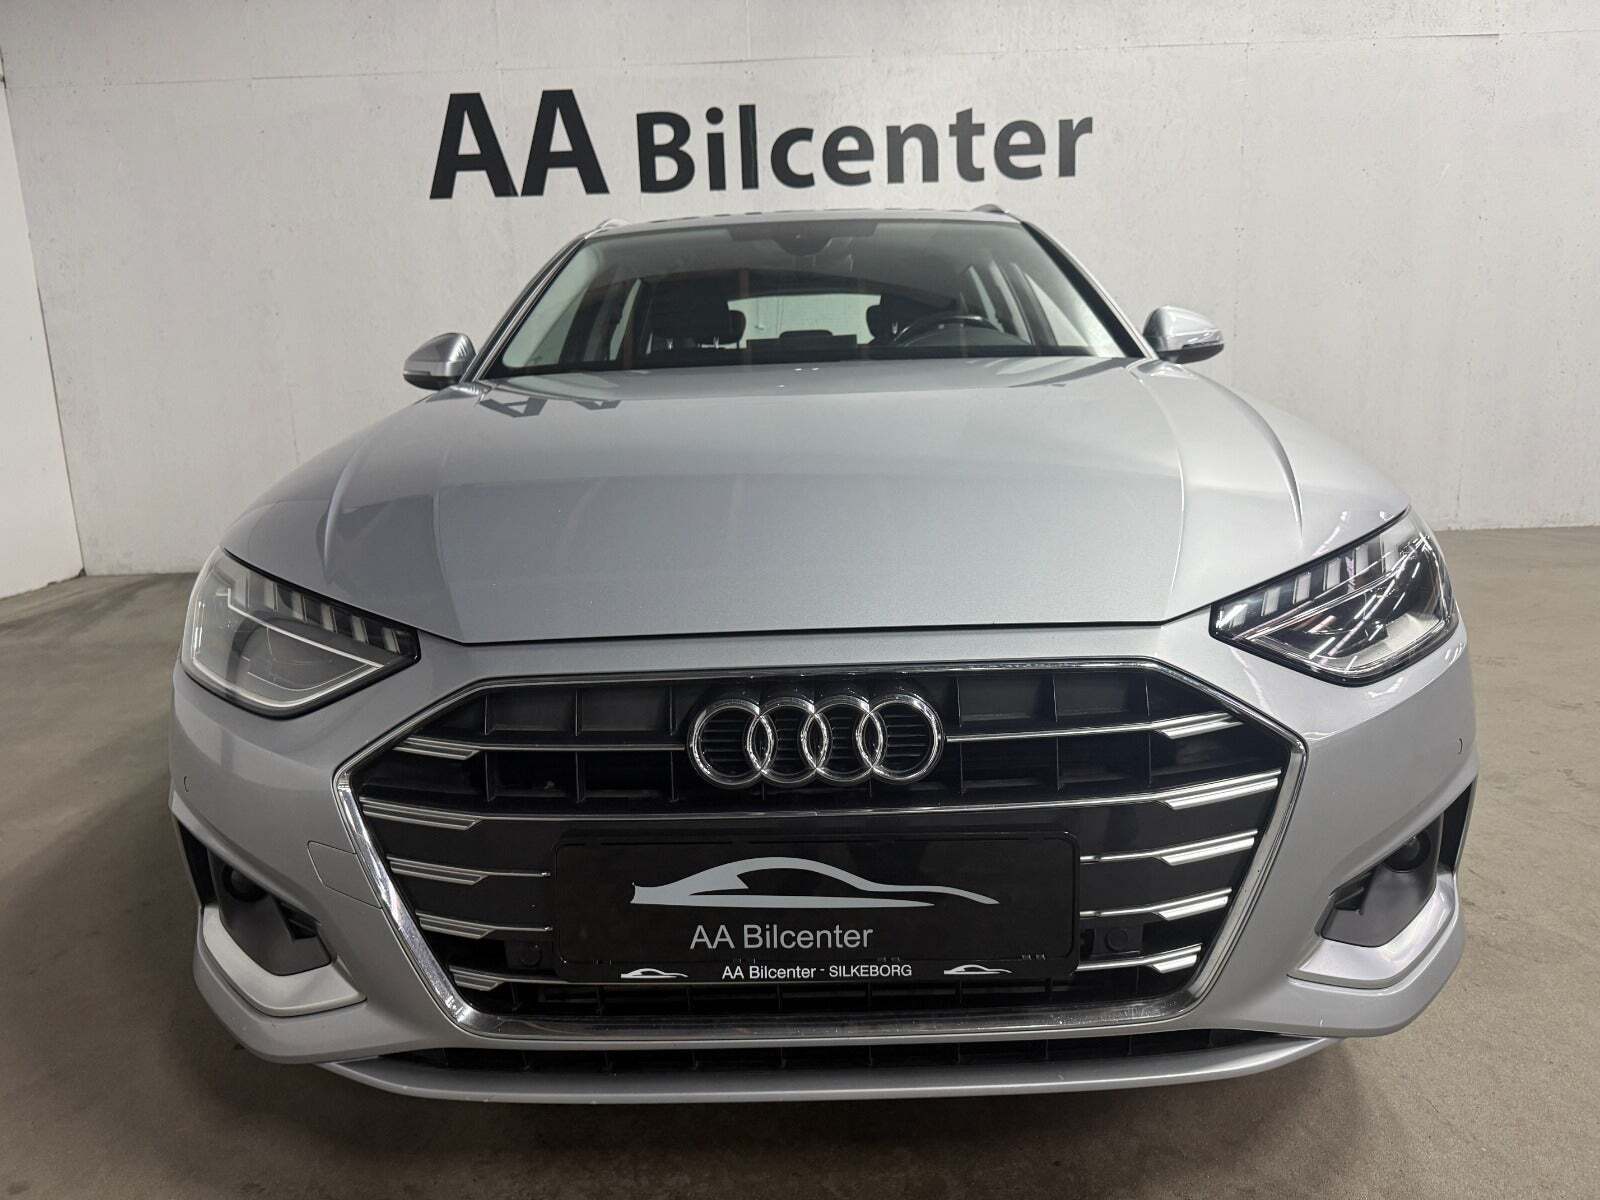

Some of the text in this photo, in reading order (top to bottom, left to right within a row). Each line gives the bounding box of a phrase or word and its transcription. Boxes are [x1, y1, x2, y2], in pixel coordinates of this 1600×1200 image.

[430, 90, 1093, 199] AA Bilcenter
[690, 924, 874, 950] AA Bilcenter
[721, 965, 745, 979] AA
[749, 965, 817, 979] Bilcenter
[829, 964, 912, 978] SILKEBORG
